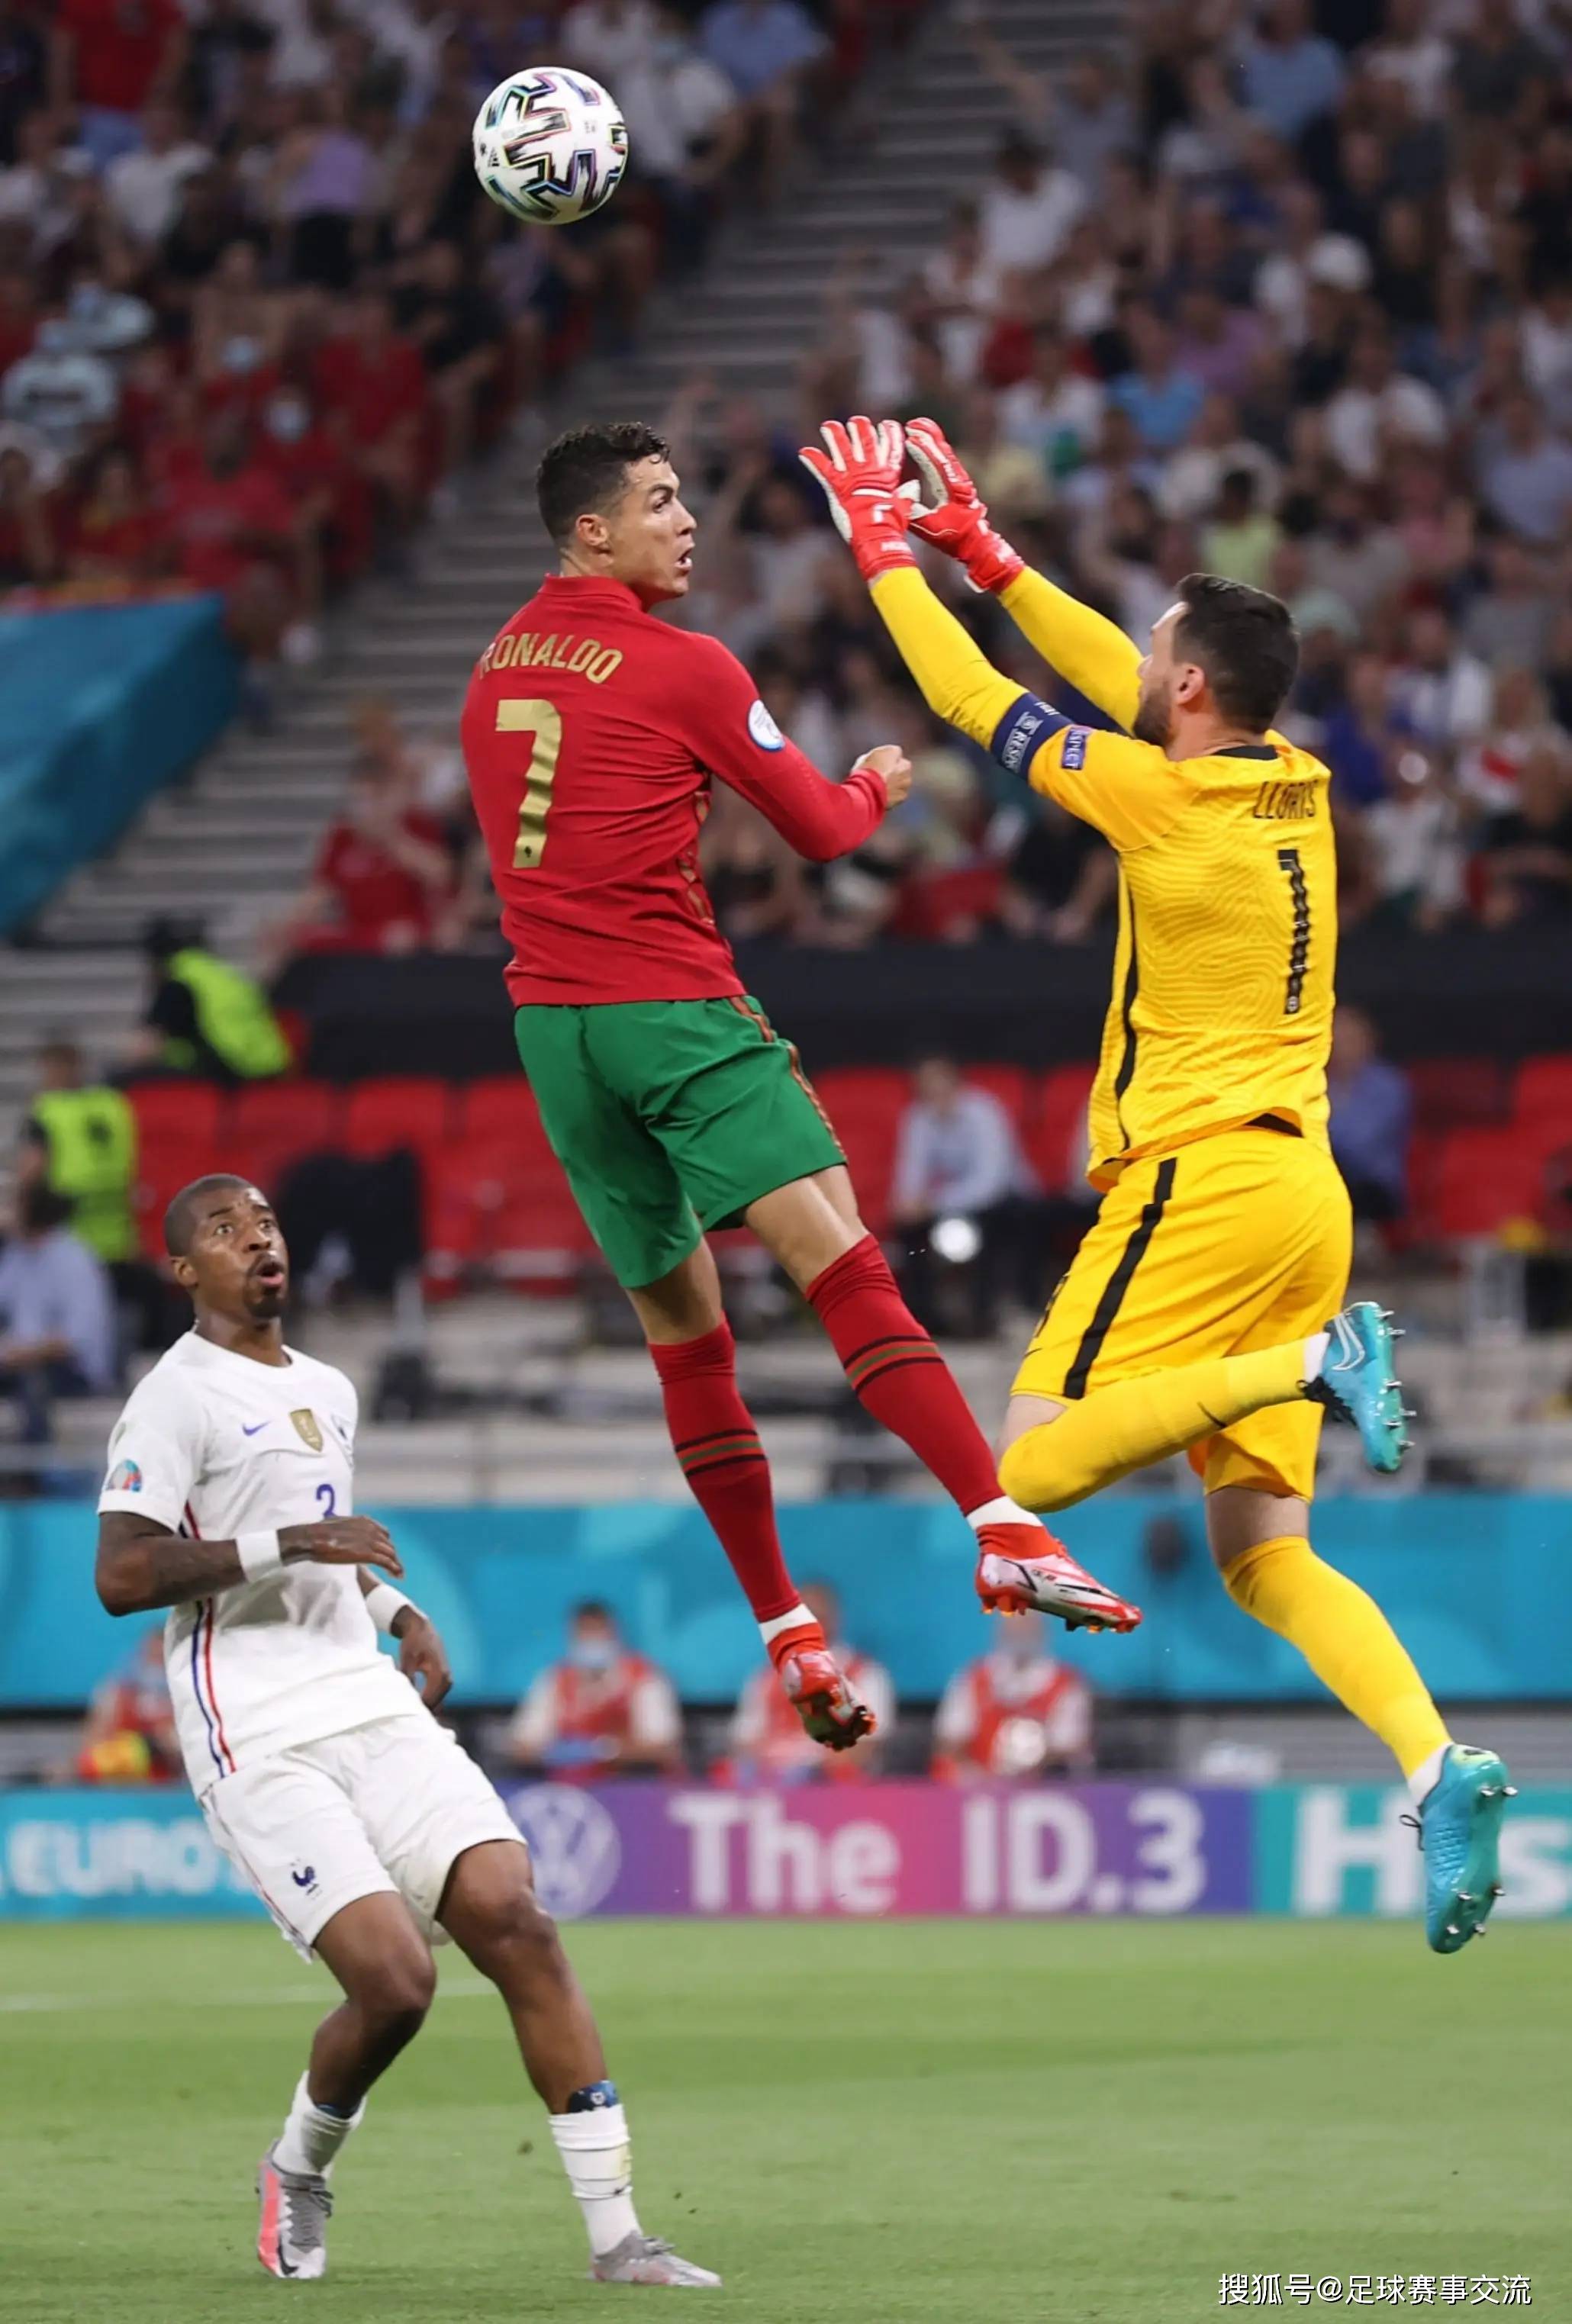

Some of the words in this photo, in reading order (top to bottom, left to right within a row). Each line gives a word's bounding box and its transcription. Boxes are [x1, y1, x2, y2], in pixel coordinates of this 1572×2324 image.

[479, 633, 623, 684] RONALDO
[495, 699, 562, 869] 7
[1277, 848, 1310, 1016] 1
[9, 1817, 219, 1895] EURO
[668, 1788, 902, 1914] The
[962, 1789, 1207, 1916] ID.3
